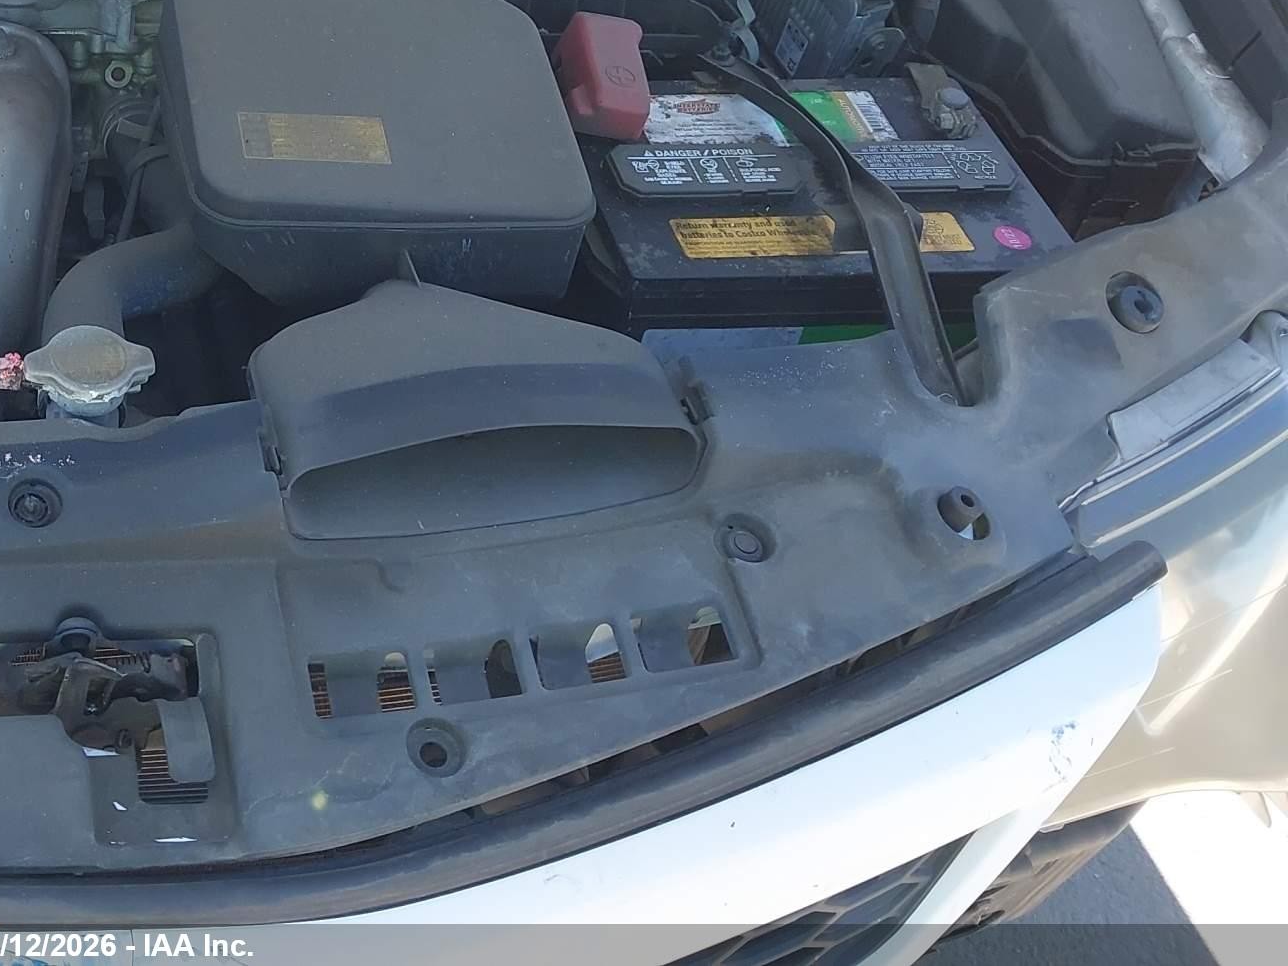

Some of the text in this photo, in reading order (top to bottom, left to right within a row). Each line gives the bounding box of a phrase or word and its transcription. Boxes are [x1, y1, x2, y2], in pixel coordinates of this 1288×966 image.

[655, 149, 701, 157] DANGER
[712, 148, 754, 156] POISON
[676, 222, 708, 230] Return
[754, 220, 772, 228] and
[735, 230, 765, 238] Costco
